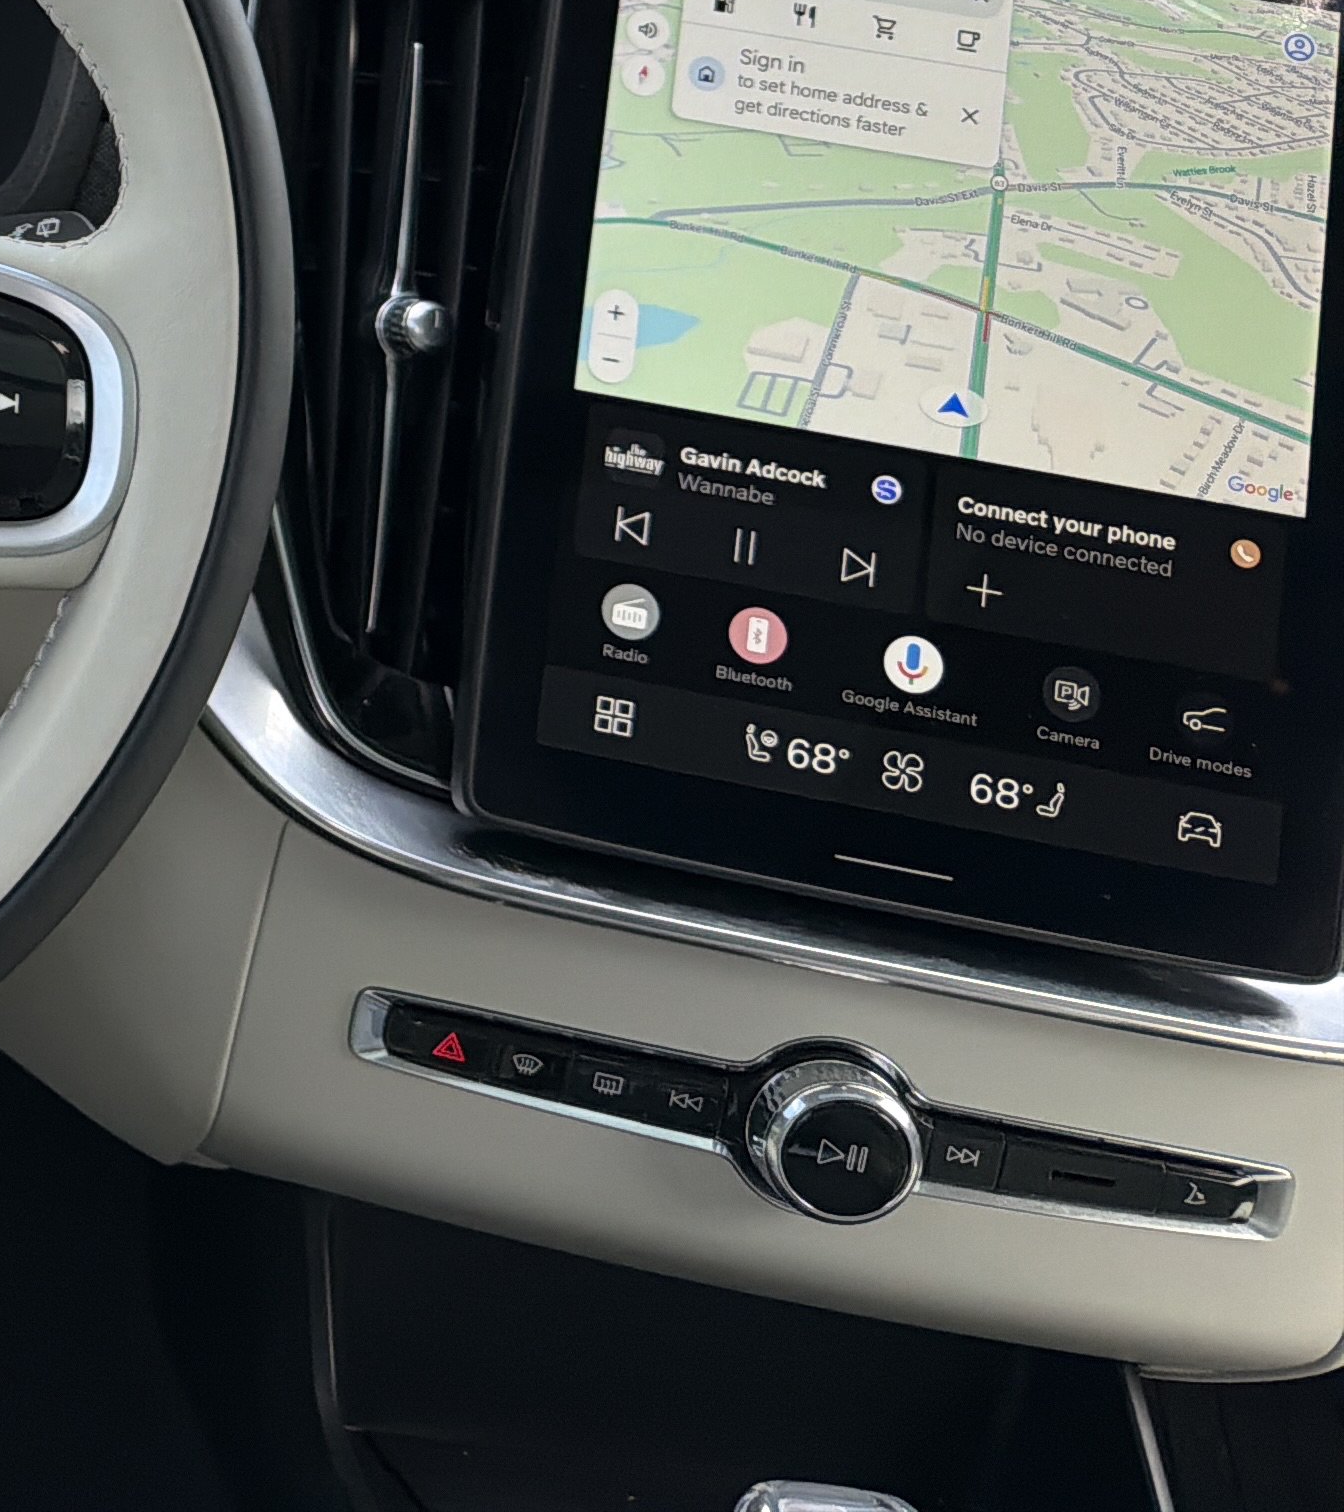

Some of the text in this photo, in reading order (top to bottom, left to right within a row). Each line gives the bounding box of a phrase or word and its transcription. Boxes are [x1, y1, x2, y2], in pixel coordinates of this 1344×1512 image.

[739, 48, 805, 74] Sign in
[737, 73, 928, 117] to set home address &
[734, 98, 906, 139] get directions faster
[604, 445, 666, 477] highway
[679, 446, 827, 489] Gavin Adcock
[1211, 436, 1237, 477] Meadow
[678, 472, 776, 506] Wannabe
[1228, 475, 1294, 502] Google
[957, 496, 1177, 551] Connect your phone
[955, 522, 1174, 579] No device connected
[602, 643, 649, 665] Radio
[715, 665, 793, 692] Bluetooth
[841, 688, 978, 727] Google Assistant
[786, 738, 851, 775] 68°
[1036, 726, 1100, 750] Camera
[1149, 745, 1253, 779] Drive modes
[969, 772, 1034, 809] 68°
